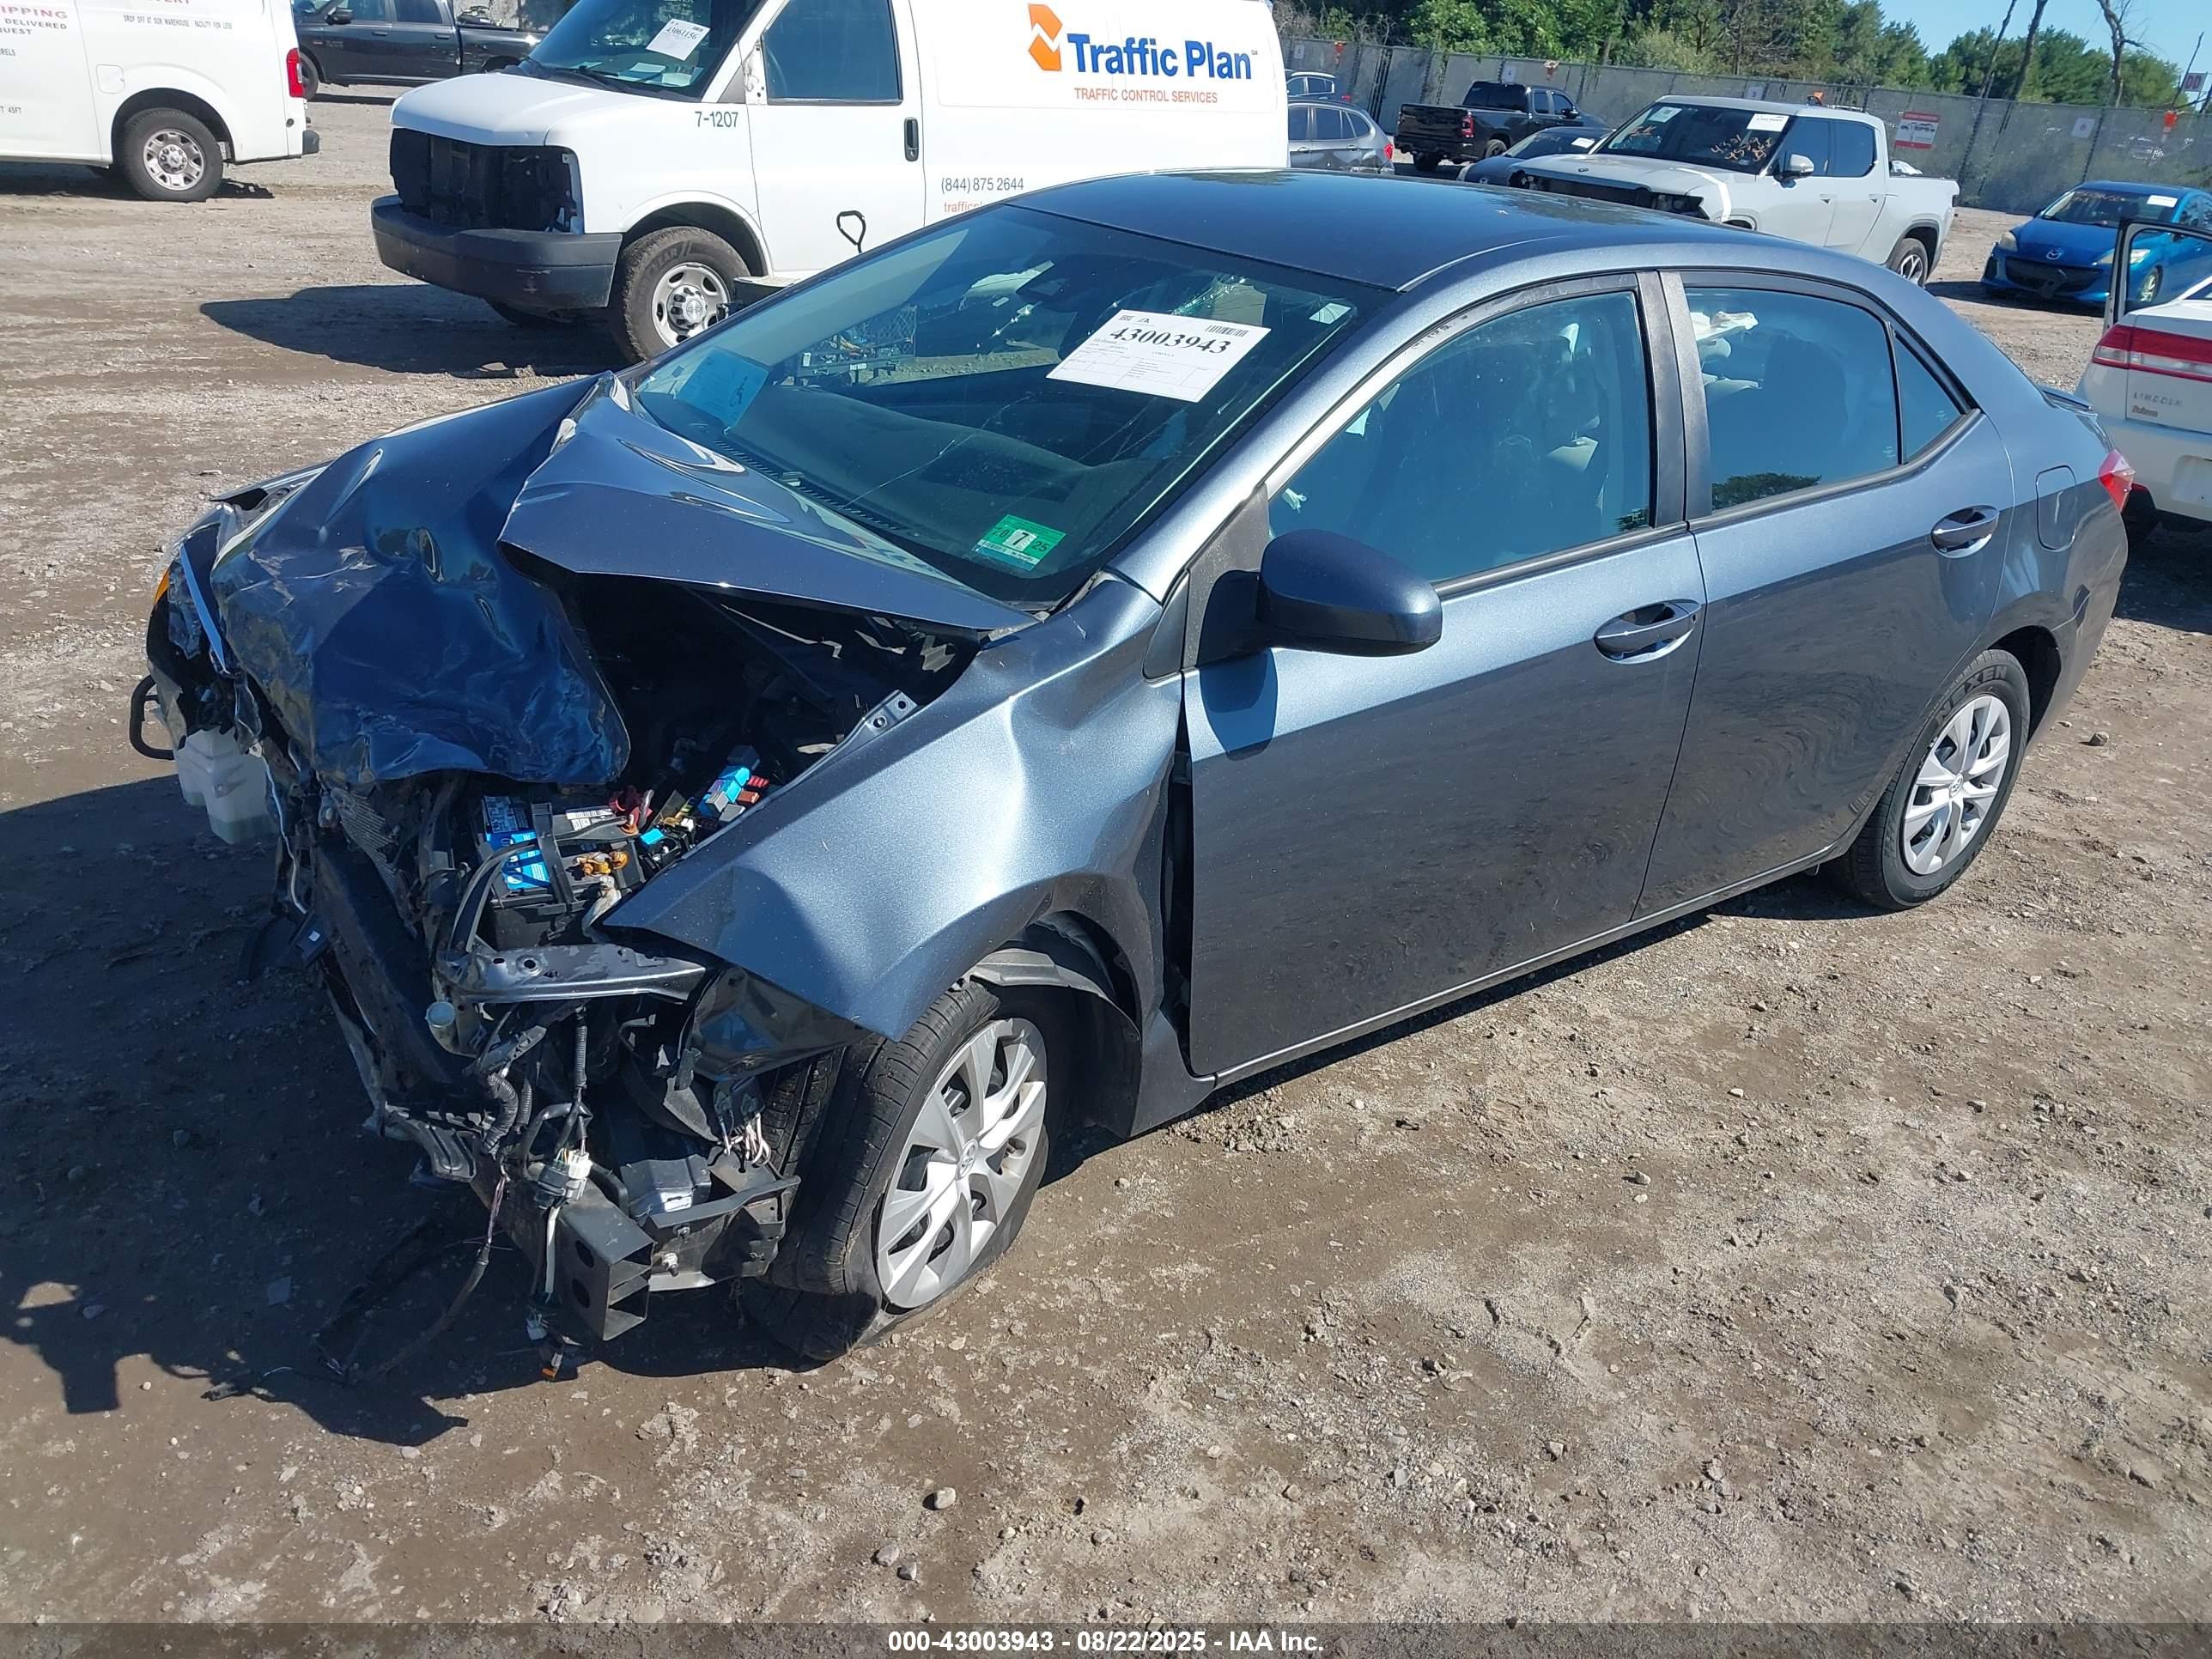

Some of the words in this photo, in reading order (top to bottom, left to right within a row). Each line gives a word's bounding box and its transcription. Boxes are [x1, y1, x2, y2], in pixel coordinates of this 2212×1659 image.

[5, 18, 68, 30] DELIVERED
[164, 18, 190, 27] WAREHOUSE
[1066, 33, 1179, 77] Traffic
[1185, 40, 1252, 80] Plan
[1073, 88, 1119, 100] TRAFFIC
[1121, 88, 1170, 102] CONTROL
[1171, 90, 1218, 104] SERVICES
[694, 111, 738, 128] 7-1207
[941, 177, 971, 195] (844)
[972, 177, 994, 191] 875
[996, 177, 1024, 191] 2644
[1109, 326, 1231, 354] 43003943
[1013, 532, 1029, 546] 7
[1031, 541, 1050, 552] 25
[1936, 666, 2008, 725] NEXEN
